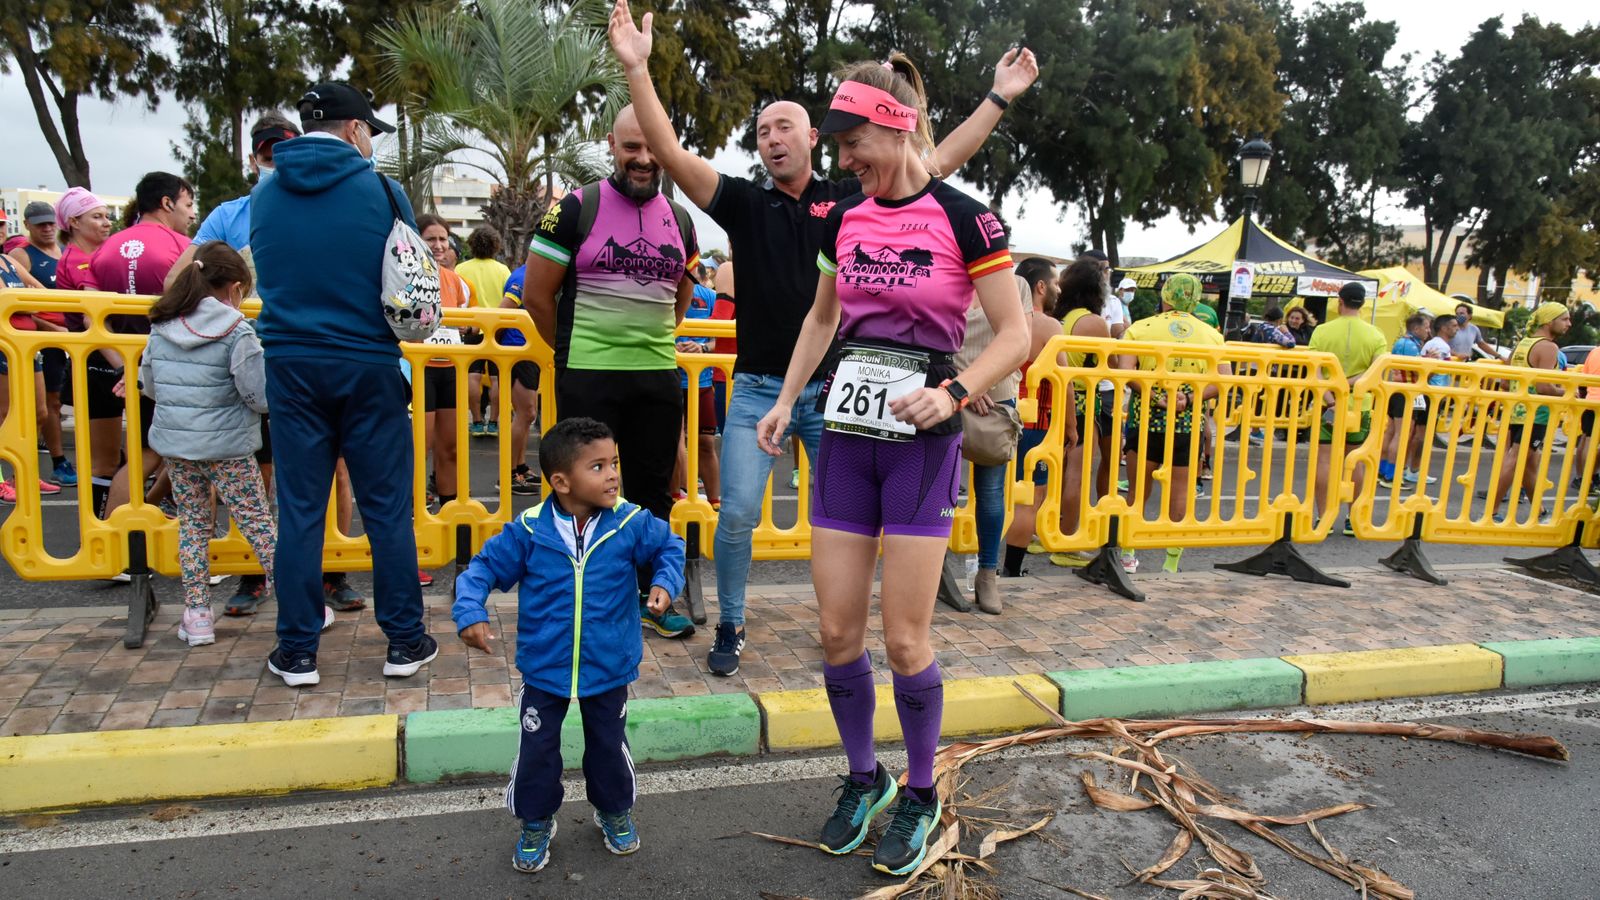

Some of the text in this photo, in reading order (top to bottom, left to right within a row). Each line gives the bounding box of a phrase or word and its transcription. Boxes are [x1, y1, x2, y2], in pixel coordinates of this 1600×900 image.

[842, 276, 913, 287] TRAIL
[858, 366, 891, 381] MONIKA
[837, 382, 888, 420] 261
